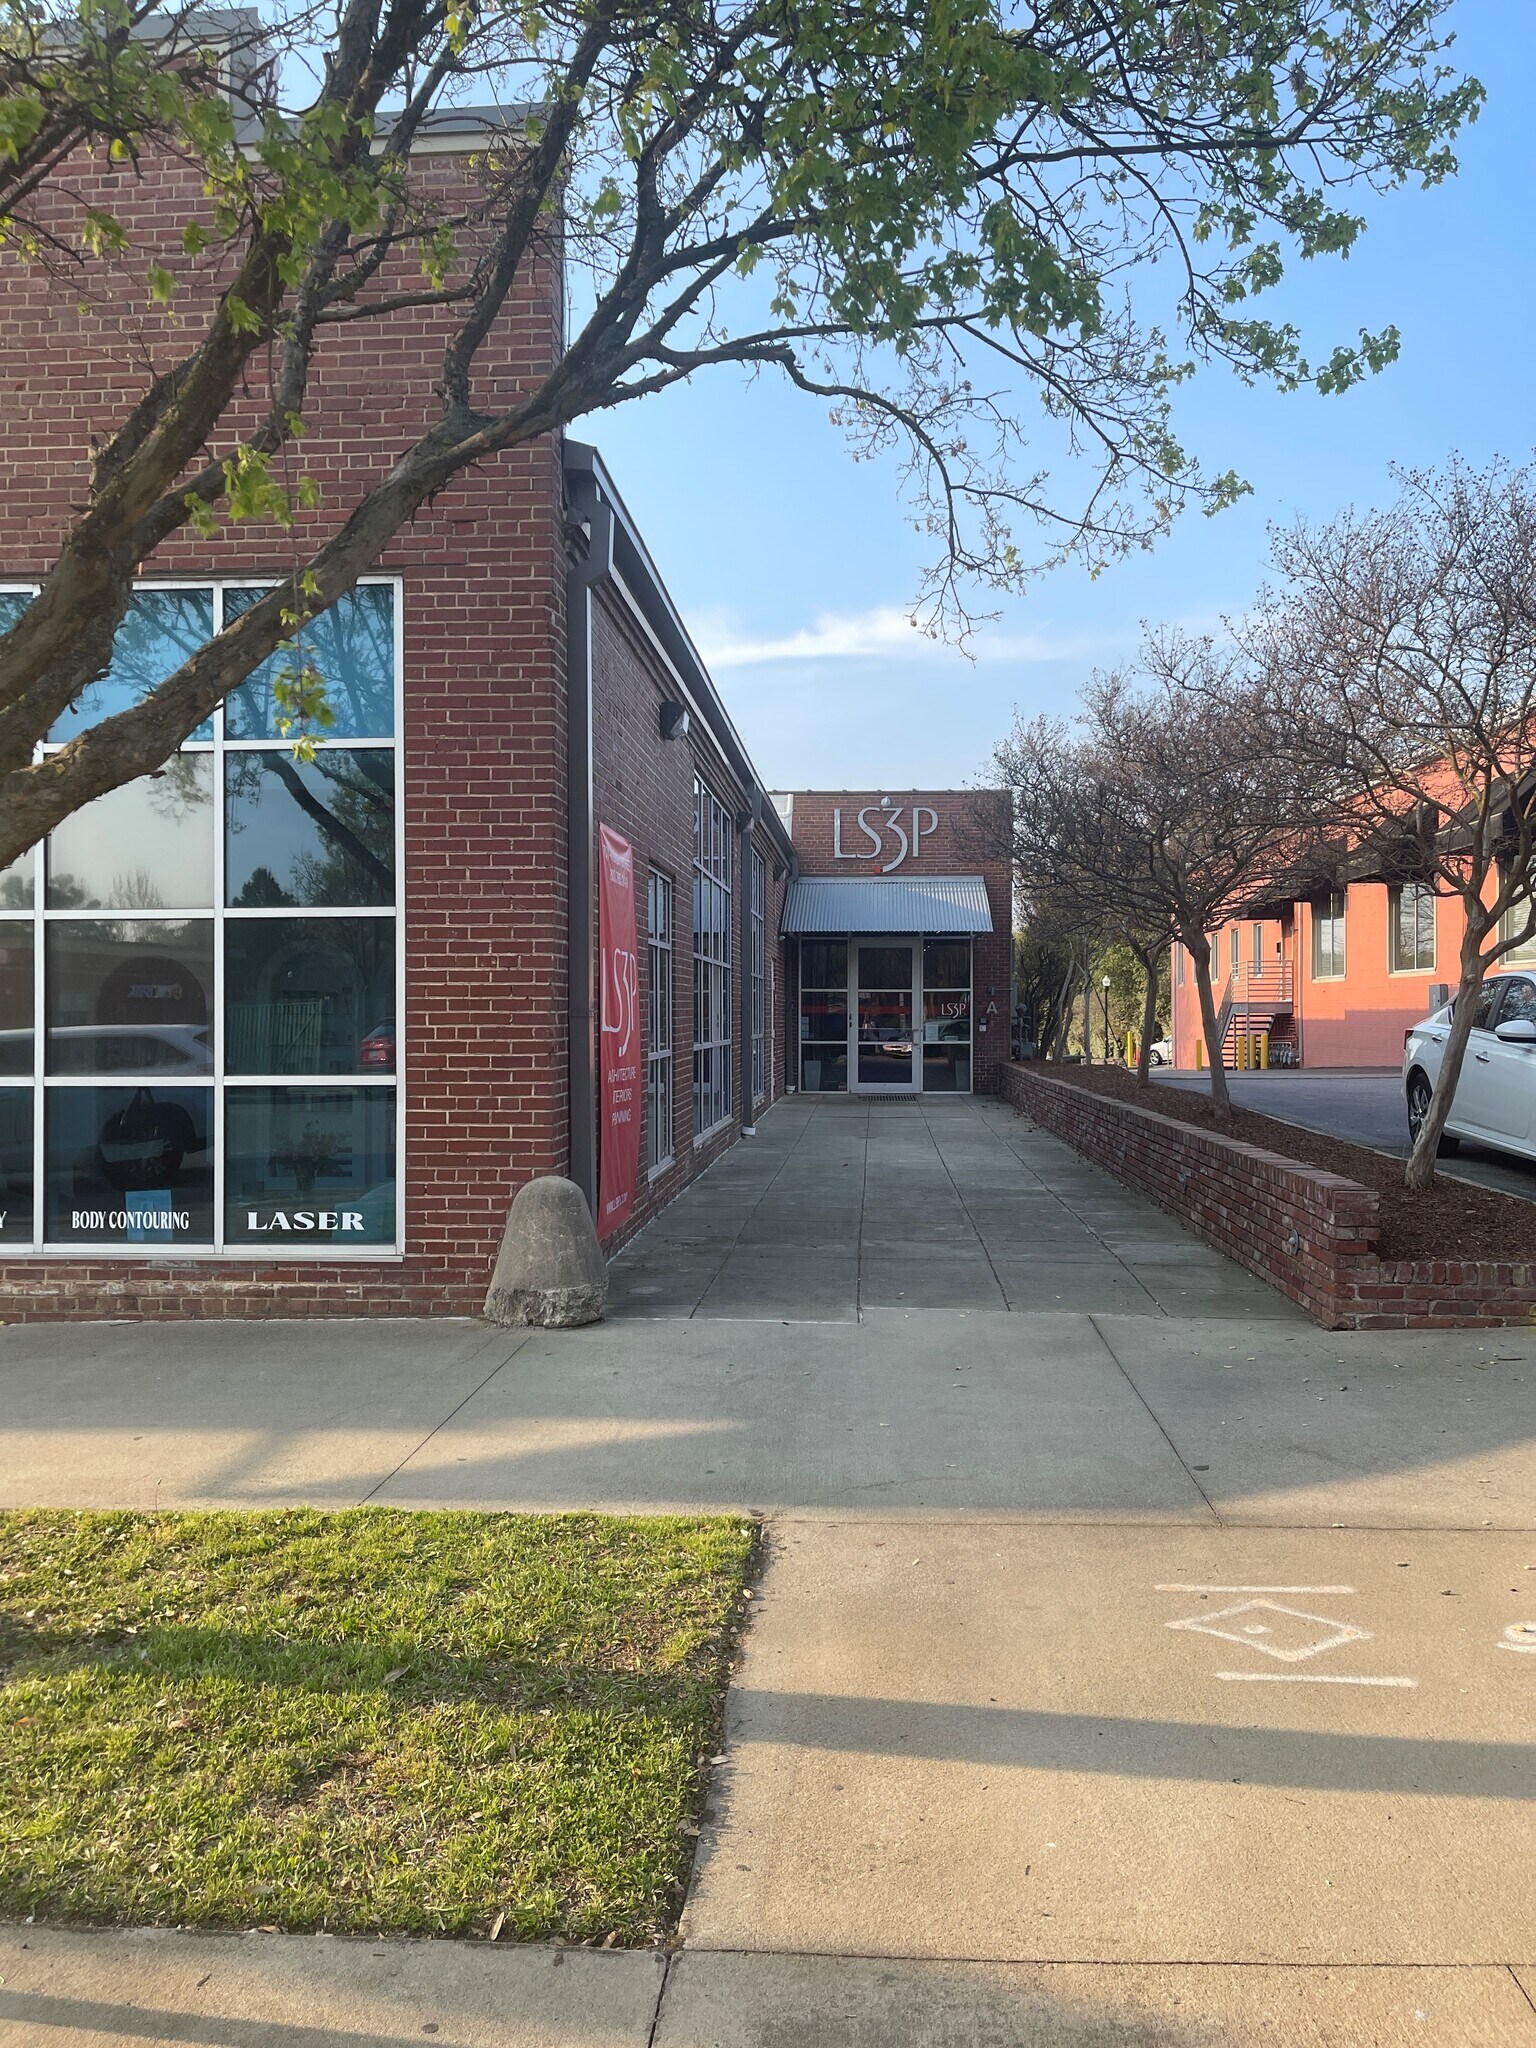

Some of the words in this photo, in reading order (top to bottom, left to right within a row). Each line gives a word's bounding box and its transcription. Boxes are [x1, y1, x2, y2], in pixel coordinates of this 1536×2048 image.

[834, 806, 939, 873] LS3P
[602, 947, 637, 1057] LS3P
[941, 1002, 967, 1019] LS3P
[986, 1001, 998, 1014] A
[71, 1211, 106, 1229] BODY
[108, 1211, 190, 1230] CONTOURING
[247, 1211, 365, 1231] LASER
